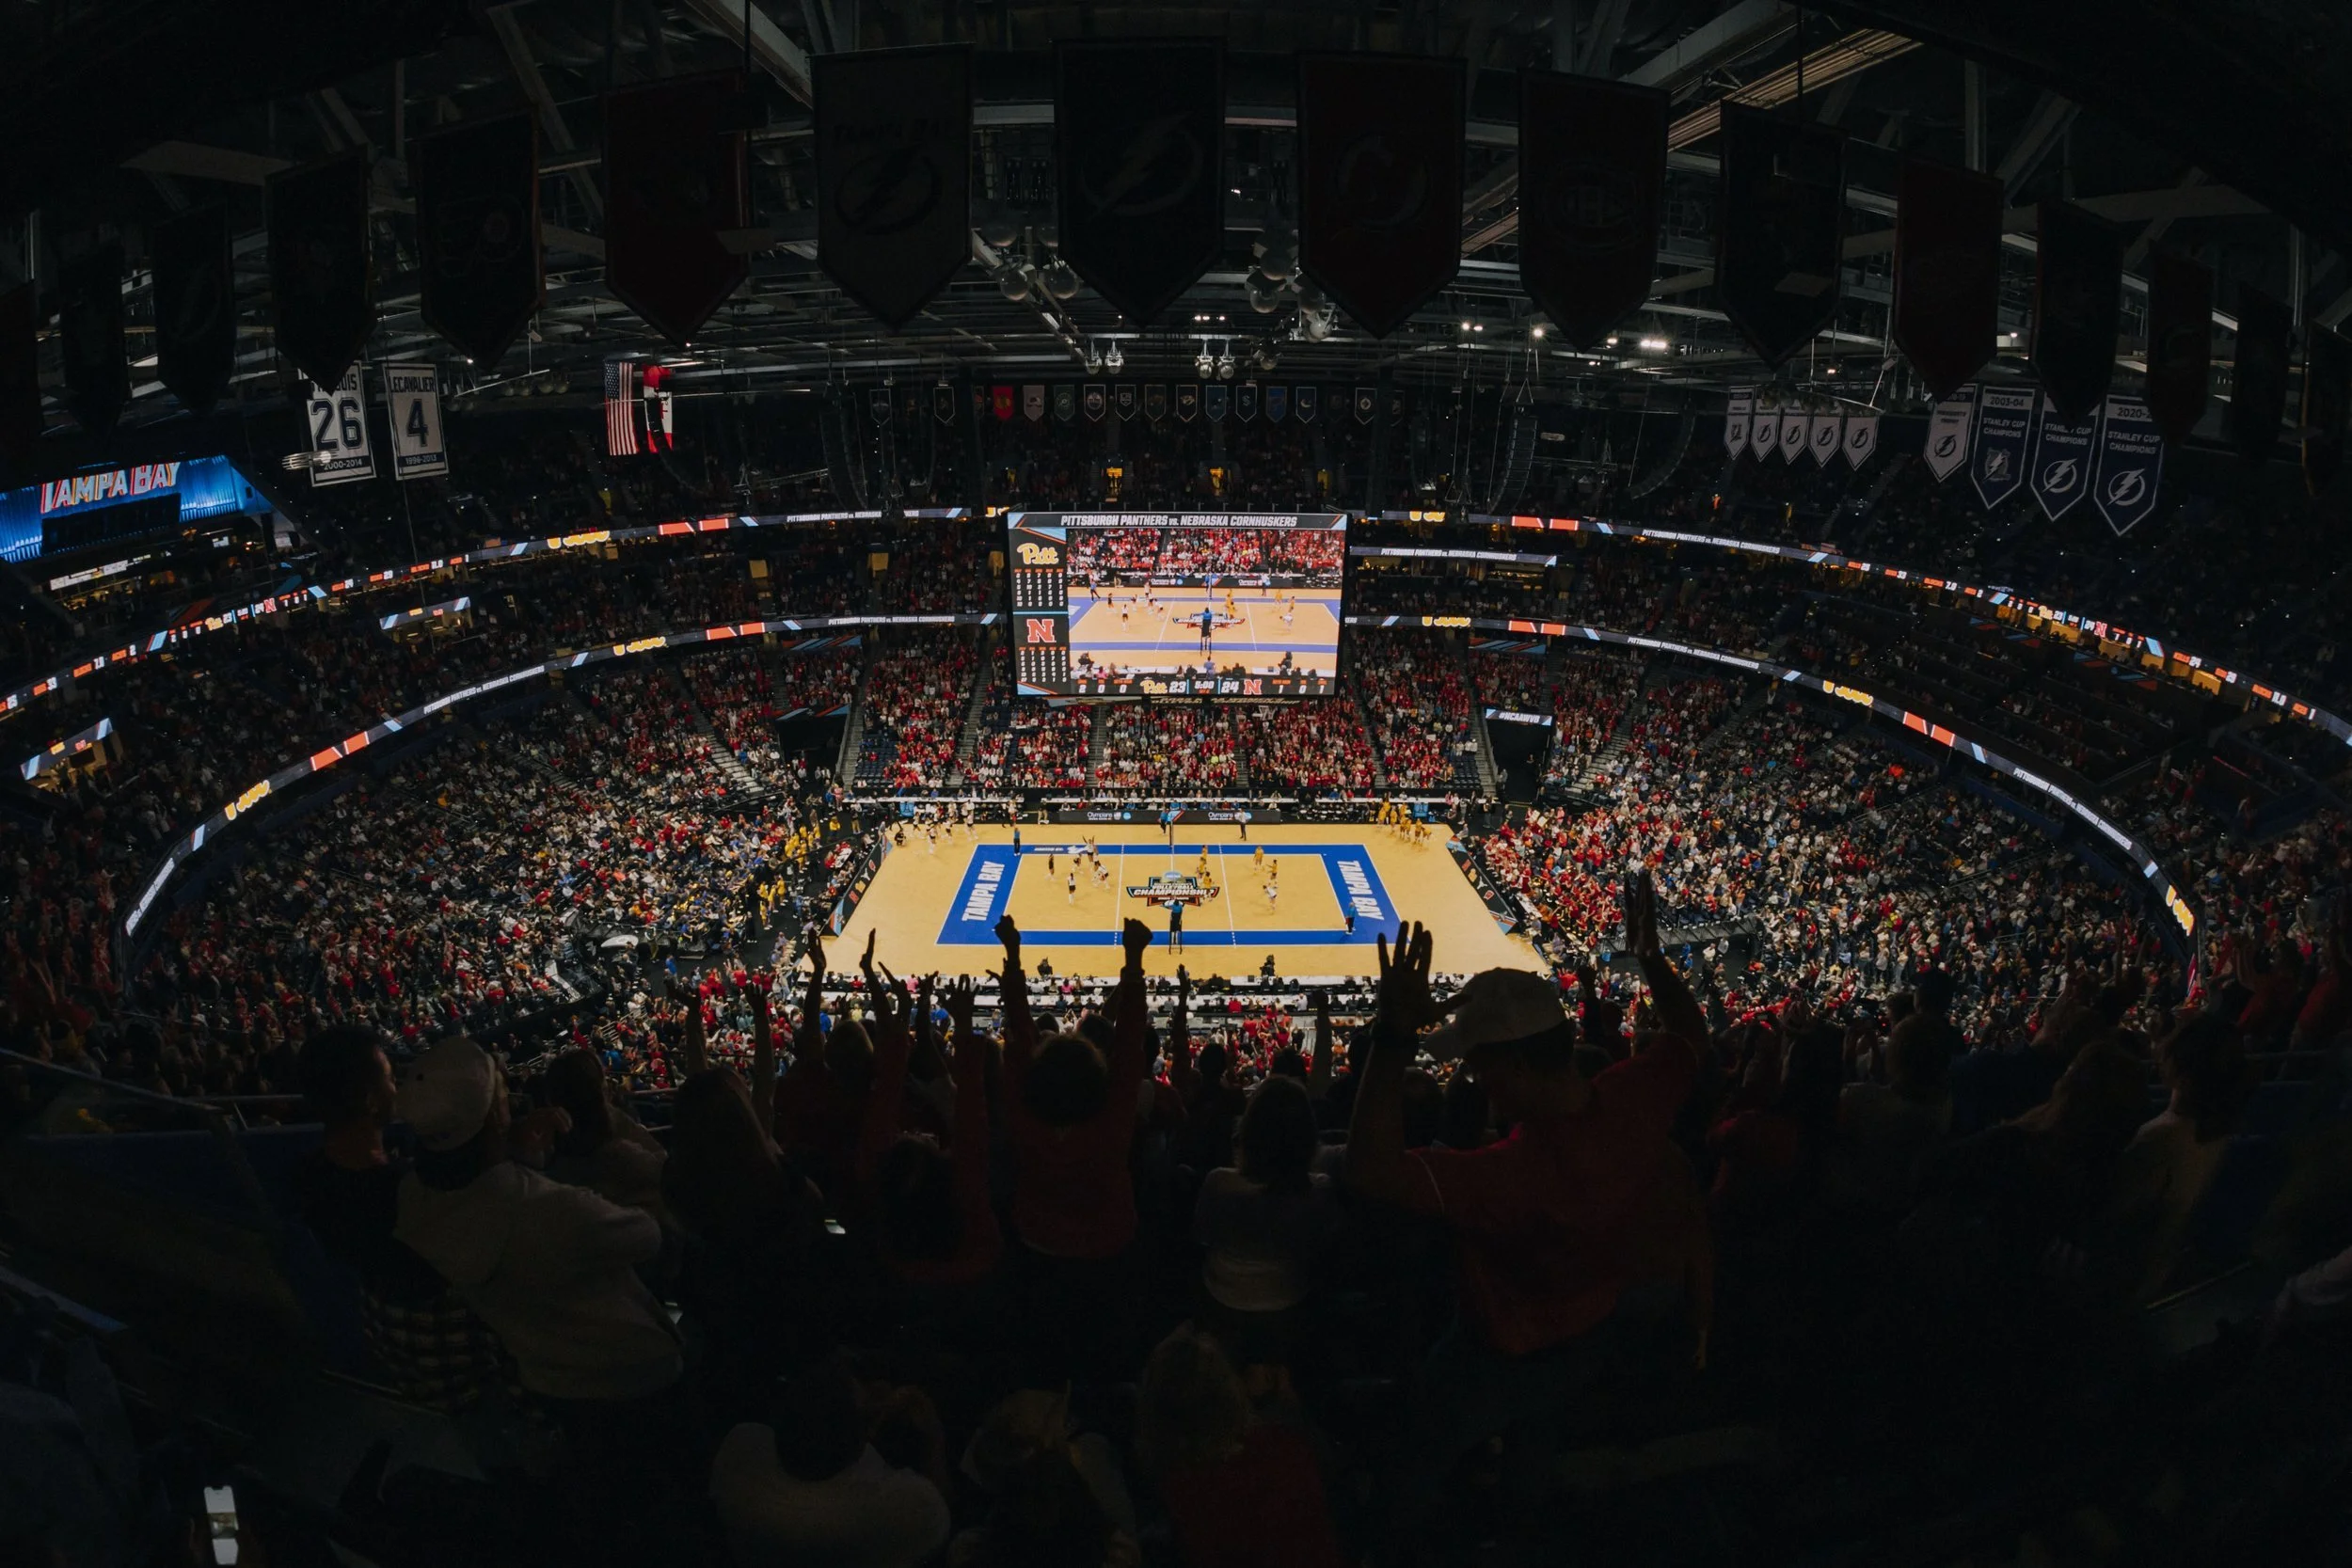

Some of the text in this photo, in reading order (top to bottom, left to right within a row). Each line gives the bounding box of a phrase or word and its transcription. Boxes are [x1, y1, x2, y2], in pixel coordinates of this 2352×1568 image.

[390, 376, 436, 392] LECAVALIER
[1990, 396, 2025, 406] 2003-04
[2118, 407, 2152, 419] 2020-2
[310, 397, 363, 451] 26
[406, 399, 429, 448] 4
[1982, 417, 2011, 427] STANLEY
[1983, 427, 2022, 438] CHAMPIONS
[2045, 433, 2089, 446] CHAMPIONS
[2107, 430, 2161, 444] STANLEY CUP
[2109, 442, 2156, 454] CHAMPIONS
[324, 458, 363, 470] 2000-2014
[1060, 515, 1119, 526] PITTSBURGH
[1120, 515, 1168, 526] PANTHERS
[1180, 515, 1229, 527] NEBRASKA
[1230, 515, 1297, 528] CORNHUSKERS
[1017, 543, 1059, 564] Pitt
[263, 598, 277, 613] N
[1026, 619, 1055, 642] N
[2094, 621, 2107, 638] N
[1078, 684, 1087, 693] 2
[1098, 684, 1105, 693] 0
[1119, 684, 1127, 693] 0
[1139, 679, 1168, 694] Pitt
[1168, 681, 1186, 693] 23
[1221, 681, 1239, 693] 24
[1243, 678, 1263, 694] N
[1299, 685, 1307, 694] 0
[1499, 711, 1540, 723] #NCAAWVB
[961, 861, 1005, 921] TAMPA BAY
[1337, 860, 1385, 920] TAMPA BAY
